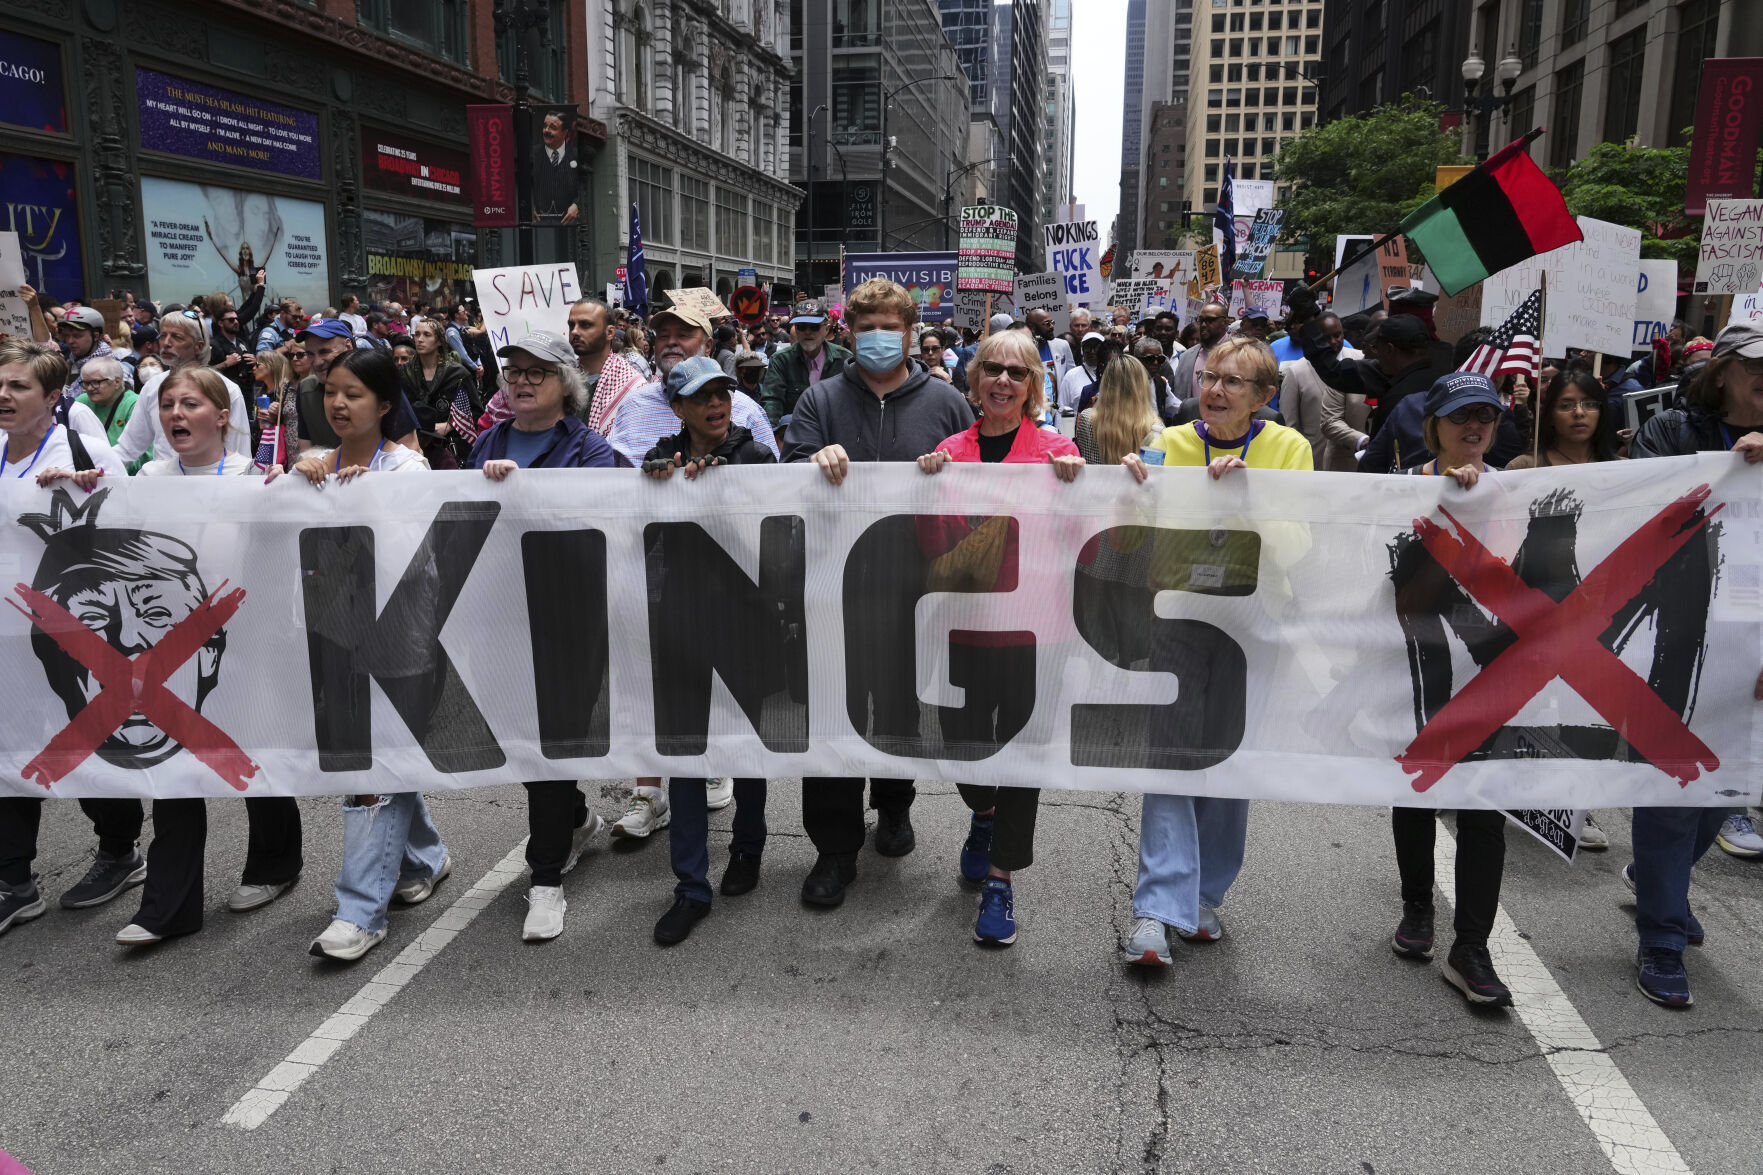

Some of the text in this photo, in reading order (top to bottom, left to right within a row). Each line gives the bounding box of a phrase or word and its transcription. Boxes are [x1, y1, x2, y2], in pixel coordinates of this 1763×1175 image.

[167, 86, 183, 99] THE
[219, 101, 246, 115] SPLASH
[246, 105, 259, 118] HIT
[260, 108, 296, 127] FEATURING
[146, 99, 157, 108] MY
[157, 101, 177, 113] HEART
[178, 106, 192, 116] WILL
[192, 109, 201, 118] GO
[202, 111, 211, 121] ON
[220, 116, 238, 127] DROVE
[239, 120, 248, 129] ALL
[248, 122, 263, 131] NIGHT
[269, 127, 275, 135] TO
[276, 129, 288, 138] LOVE
[288, 132, 299, 140] YOU
[299, 134, 312, 143] MORE
[170, 118, 180, 128] ALL
[181, 121, 189, 129] BY
[190, 122, 210, 133] MYSELF
[216, 128, 225, 136] I'M
[226, 130, 240, 140] ALIVE
[251, 135, 262, 145] NEW
[263, 138, 272, 146] DAY
[273, 140, 283, 149] HAS
[283, 142, 297, 151] COME
[1719, 75, 1752, 185] GOODMAN
[207, 141, 270, 161] AND MANY MORE!
[377, 144, 417, 161] CELEBRATING 25 YEARS
[488, 118, 502, 201] GOODMAN
[420, 165, 429, 177] IN
[430, 165, 460, 184] CHICAGO
[962, 206, 1016, 222] STOP THE
[1257, 210, 1283, 225] STOP
[151, 220, 199, 232] "A FEVER-DREAM
[962, 219, 1017, 230] TRUMP AGENDA!
[996, 228, 1017, 236] EXPAND
[1065, 220, 1098, 244] KINGS
[151, 231, 203, 242] MIRACLE CREATED
[999, 233, 1016, 241] RIGHTS
[1704, 225, 1763, 241] AGAINST
[169, 242, 197, 251] MANIFEST
[288, 244, 318, 252] GUARANTEED
[1383, 239, 1399, 257] NO
[1701, 243, 1763, 261] FASCISM
[163, 252, 178, 260] PURE
[292, 252, 307, 260] LAUGH
[1053, 247, 1093, 272] FUCK
[368, 254, 424, 280] BROADWAY
[436, 261, 474, 280] CHICAGO
[1201, 258, 1214, 270] 86
[853, 271, 952, 284] INDIVISIB
[1202, 268, 1216, 281] 47
[982, 279, 1008, 287] EDUCATION
[991, 284, 1013, 292] FREEDOM
[1017, 276, 1057, 289] Families
[1063, 273, 1090, 294] ICE
[492, 268, 576, 316] SAVE
[1024, 291, 1058, 301] Belong
[961, 294, 1000, 311] Crimils,
[955, 304, 981, 317] Trump
[969, 317, 979, 327] Be
[1447, 377, 1488, 388] INDIVISIBLE
[299, 500, 1261, 774] KINGS
